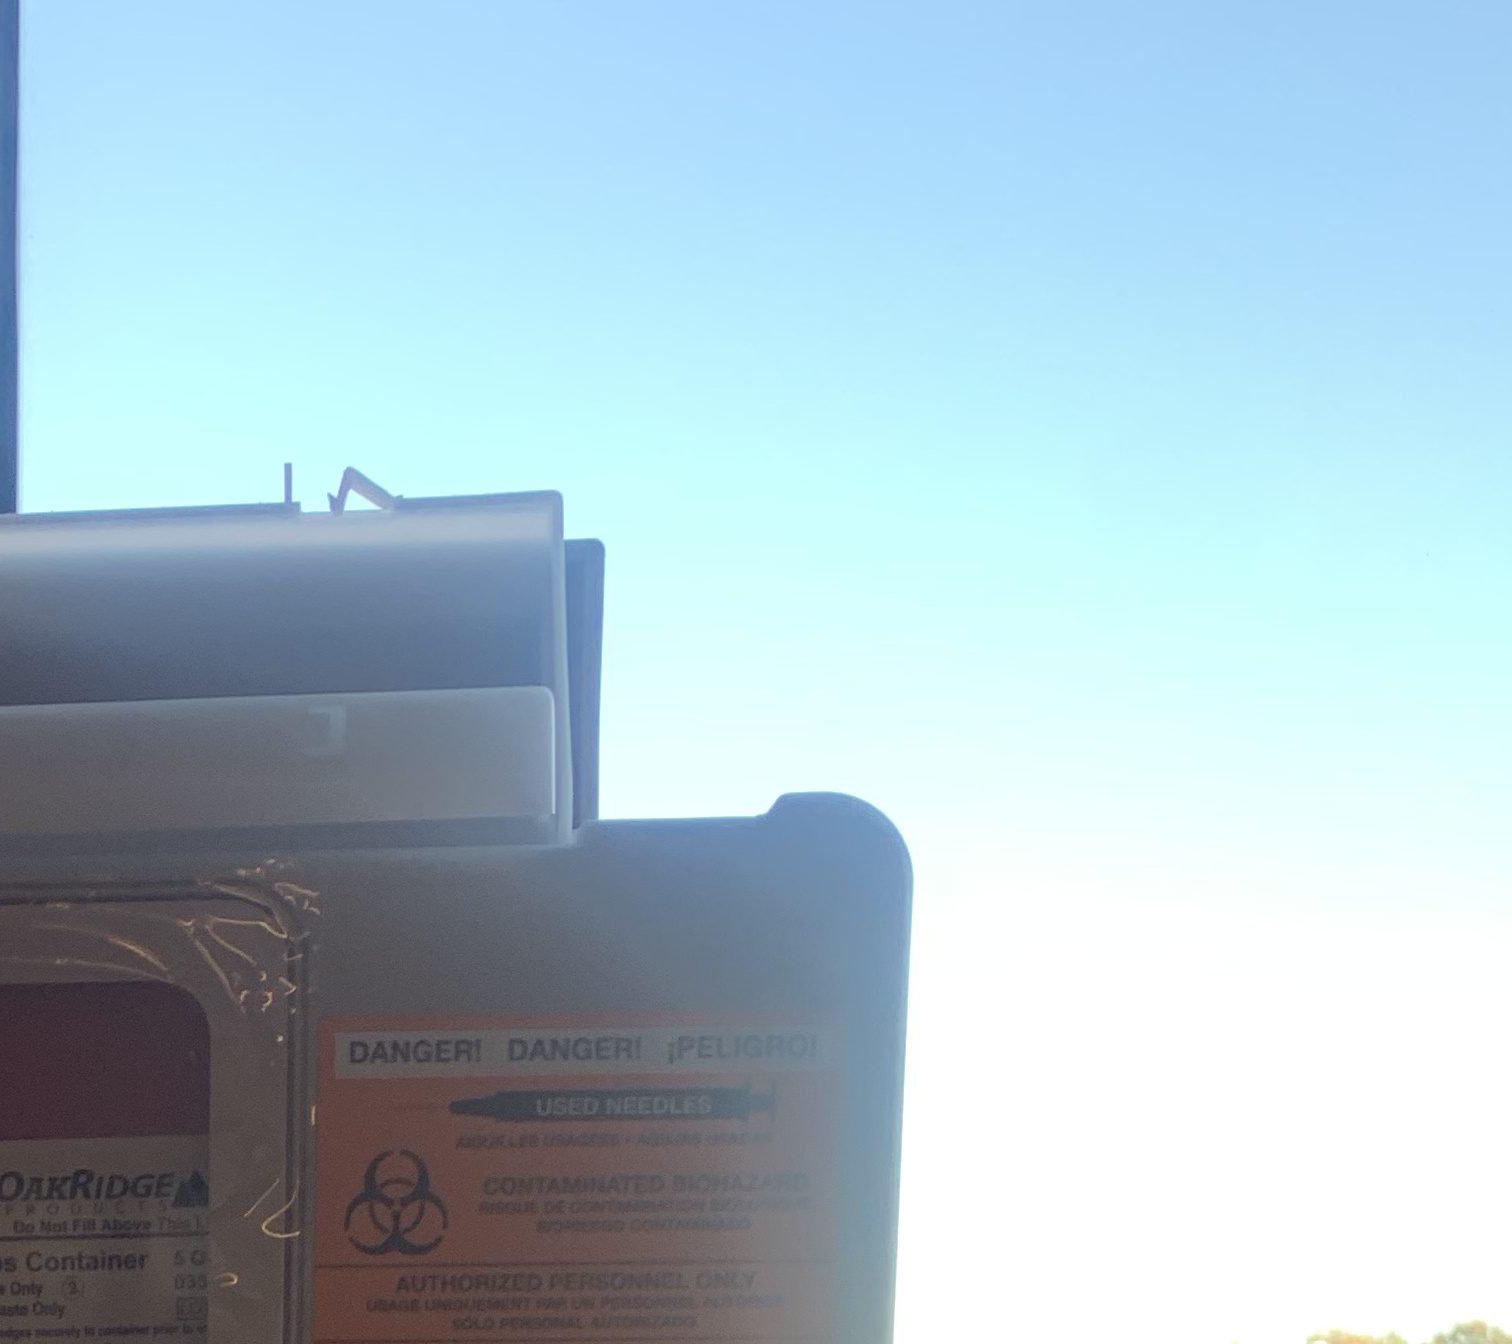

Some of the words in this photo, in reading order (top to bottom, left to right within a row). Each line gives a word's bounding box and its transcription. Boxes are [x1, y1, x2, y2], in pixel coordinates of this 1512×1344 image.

[348, 1037, 482, 1064] DANGER!
[506, 1036, 643, 1063] DANGER!
[665, 1034, 819, 1065] ¡PELIGRO!
[535, 1096, 601, 1118] USED
[604, 1094, 713, 1116] NEEDLES
[482, 1174, 666, 1196] CONTAMINATED
[671, 1172, 811, 1194] BIOHAZARD
[4, 1201, 169, 1216] PRODUCTS
[12, 1220, 35, 1235] Do
[39, 1219, 68, 1234] Not
[72, 1219, 97, 1233] Fill
[101, 1218, 152, 1232] Above
[25, 1250, 149, 1272] Container
[9, 1280, 44, 1298] Only
[395, 1273, 543, 1294] AUTHORIZED
[548, 1271, 690, 1292] PERSONNEL
[695, 1270, 758, 1291] ONLY
[32, 1300, 66, 1319] Only
